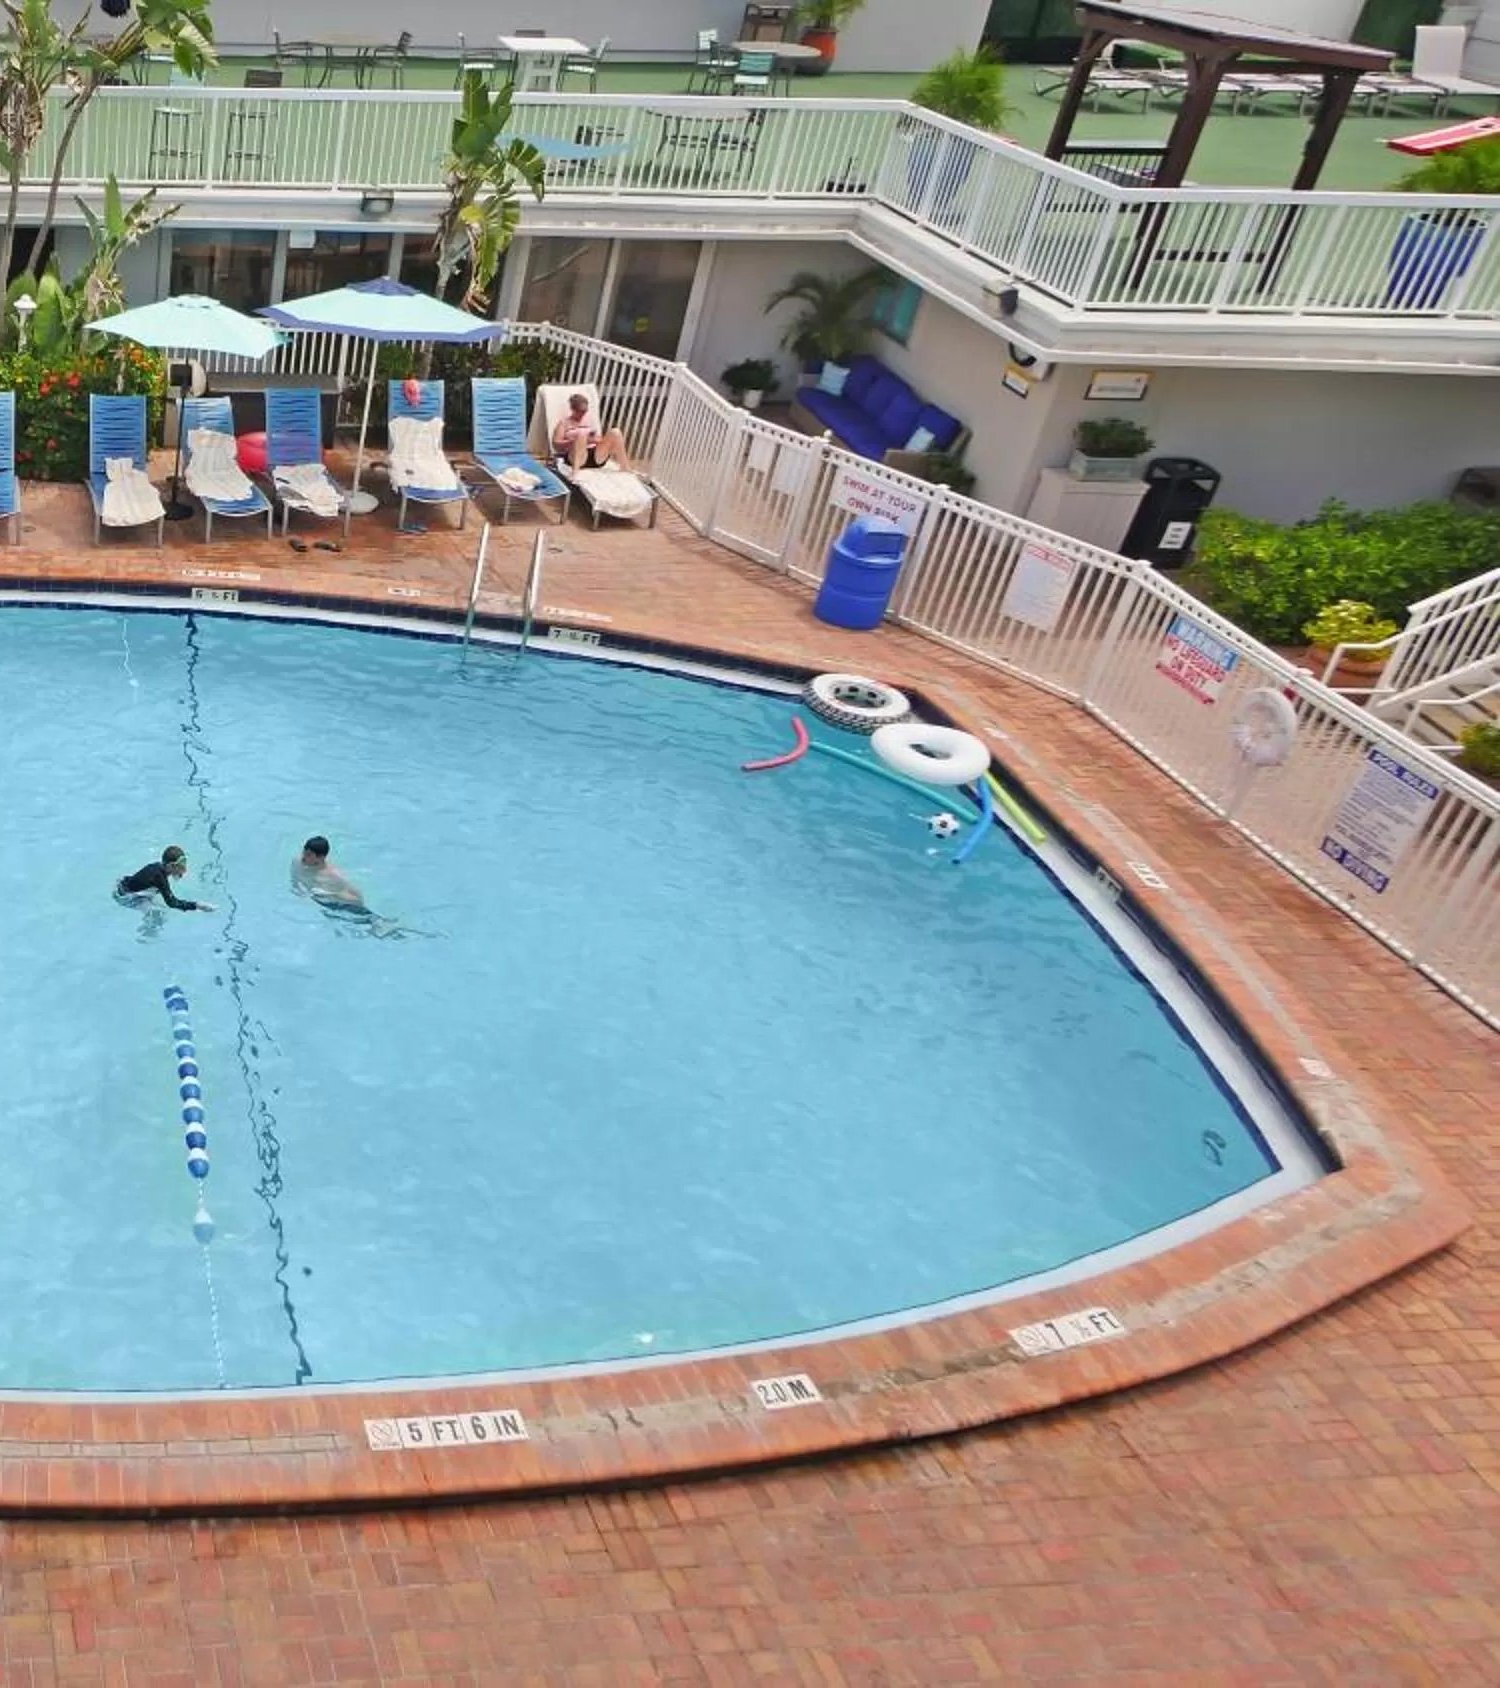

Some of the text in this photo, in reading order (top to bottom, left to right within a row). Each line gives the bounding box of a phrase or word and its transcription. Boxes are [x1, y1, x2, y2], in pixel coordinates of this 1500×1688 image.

[843, 475, 870, 494] SWIM
[887, 494, 917, 512] YOUR
[847, 497, 873, 512] OWN
[1174, 618, 1235, 670] WARNING
[1044, 1322, 1065, 1346] 7
[1087, 1311, 1119, 1333] FT
[787, 1380, 815, 1400] M.
[407, 1421, 424, 1443] 5
[470, 1415, 487, 1440] 6
